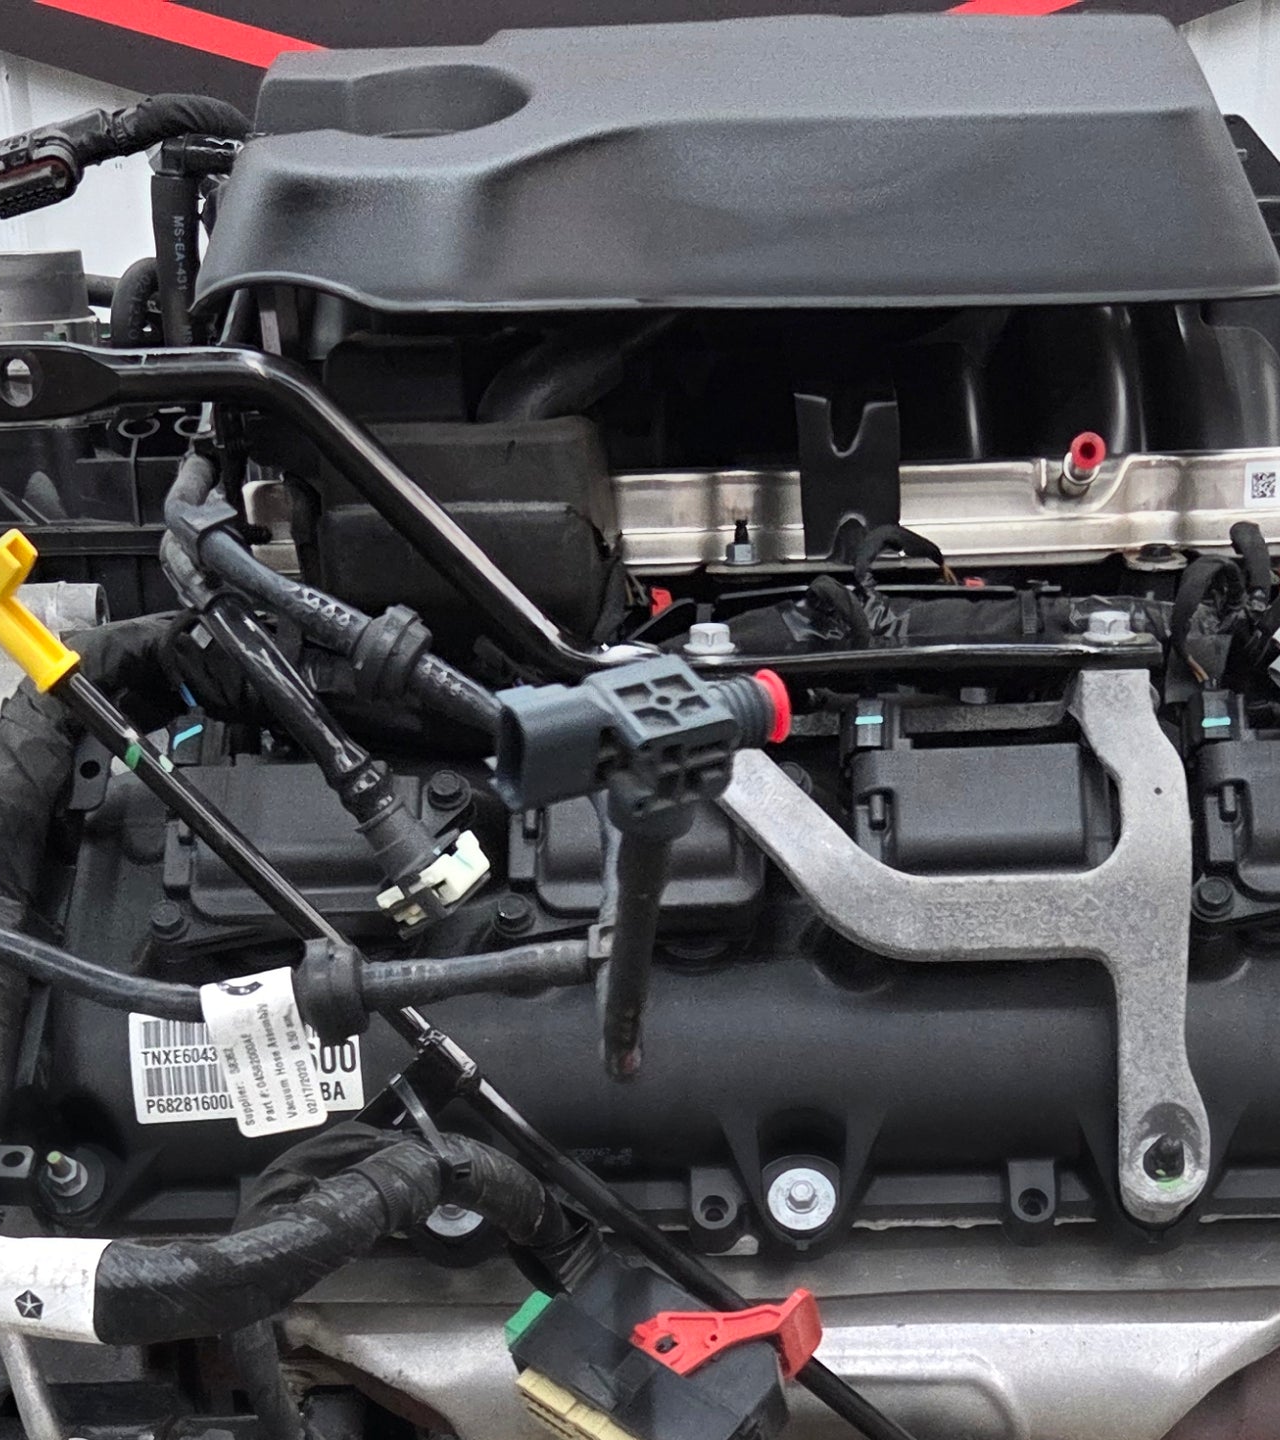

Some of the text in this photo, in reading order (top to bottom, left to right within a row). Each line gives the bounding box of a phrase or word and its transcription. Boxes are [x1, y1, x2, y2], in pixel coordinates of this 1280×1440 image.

[141, 1046, 219, 1067] TNXE6043
[256, 1003, 298, 1118] Vacuum Hose Assembly
[237, 1081, 255, 1126] Supplier:
[294, 1060, 318, 1115] 02/17/2020
[320, 1081, 346, 1101] BA
[262, 1100, 277, 1122] Part
